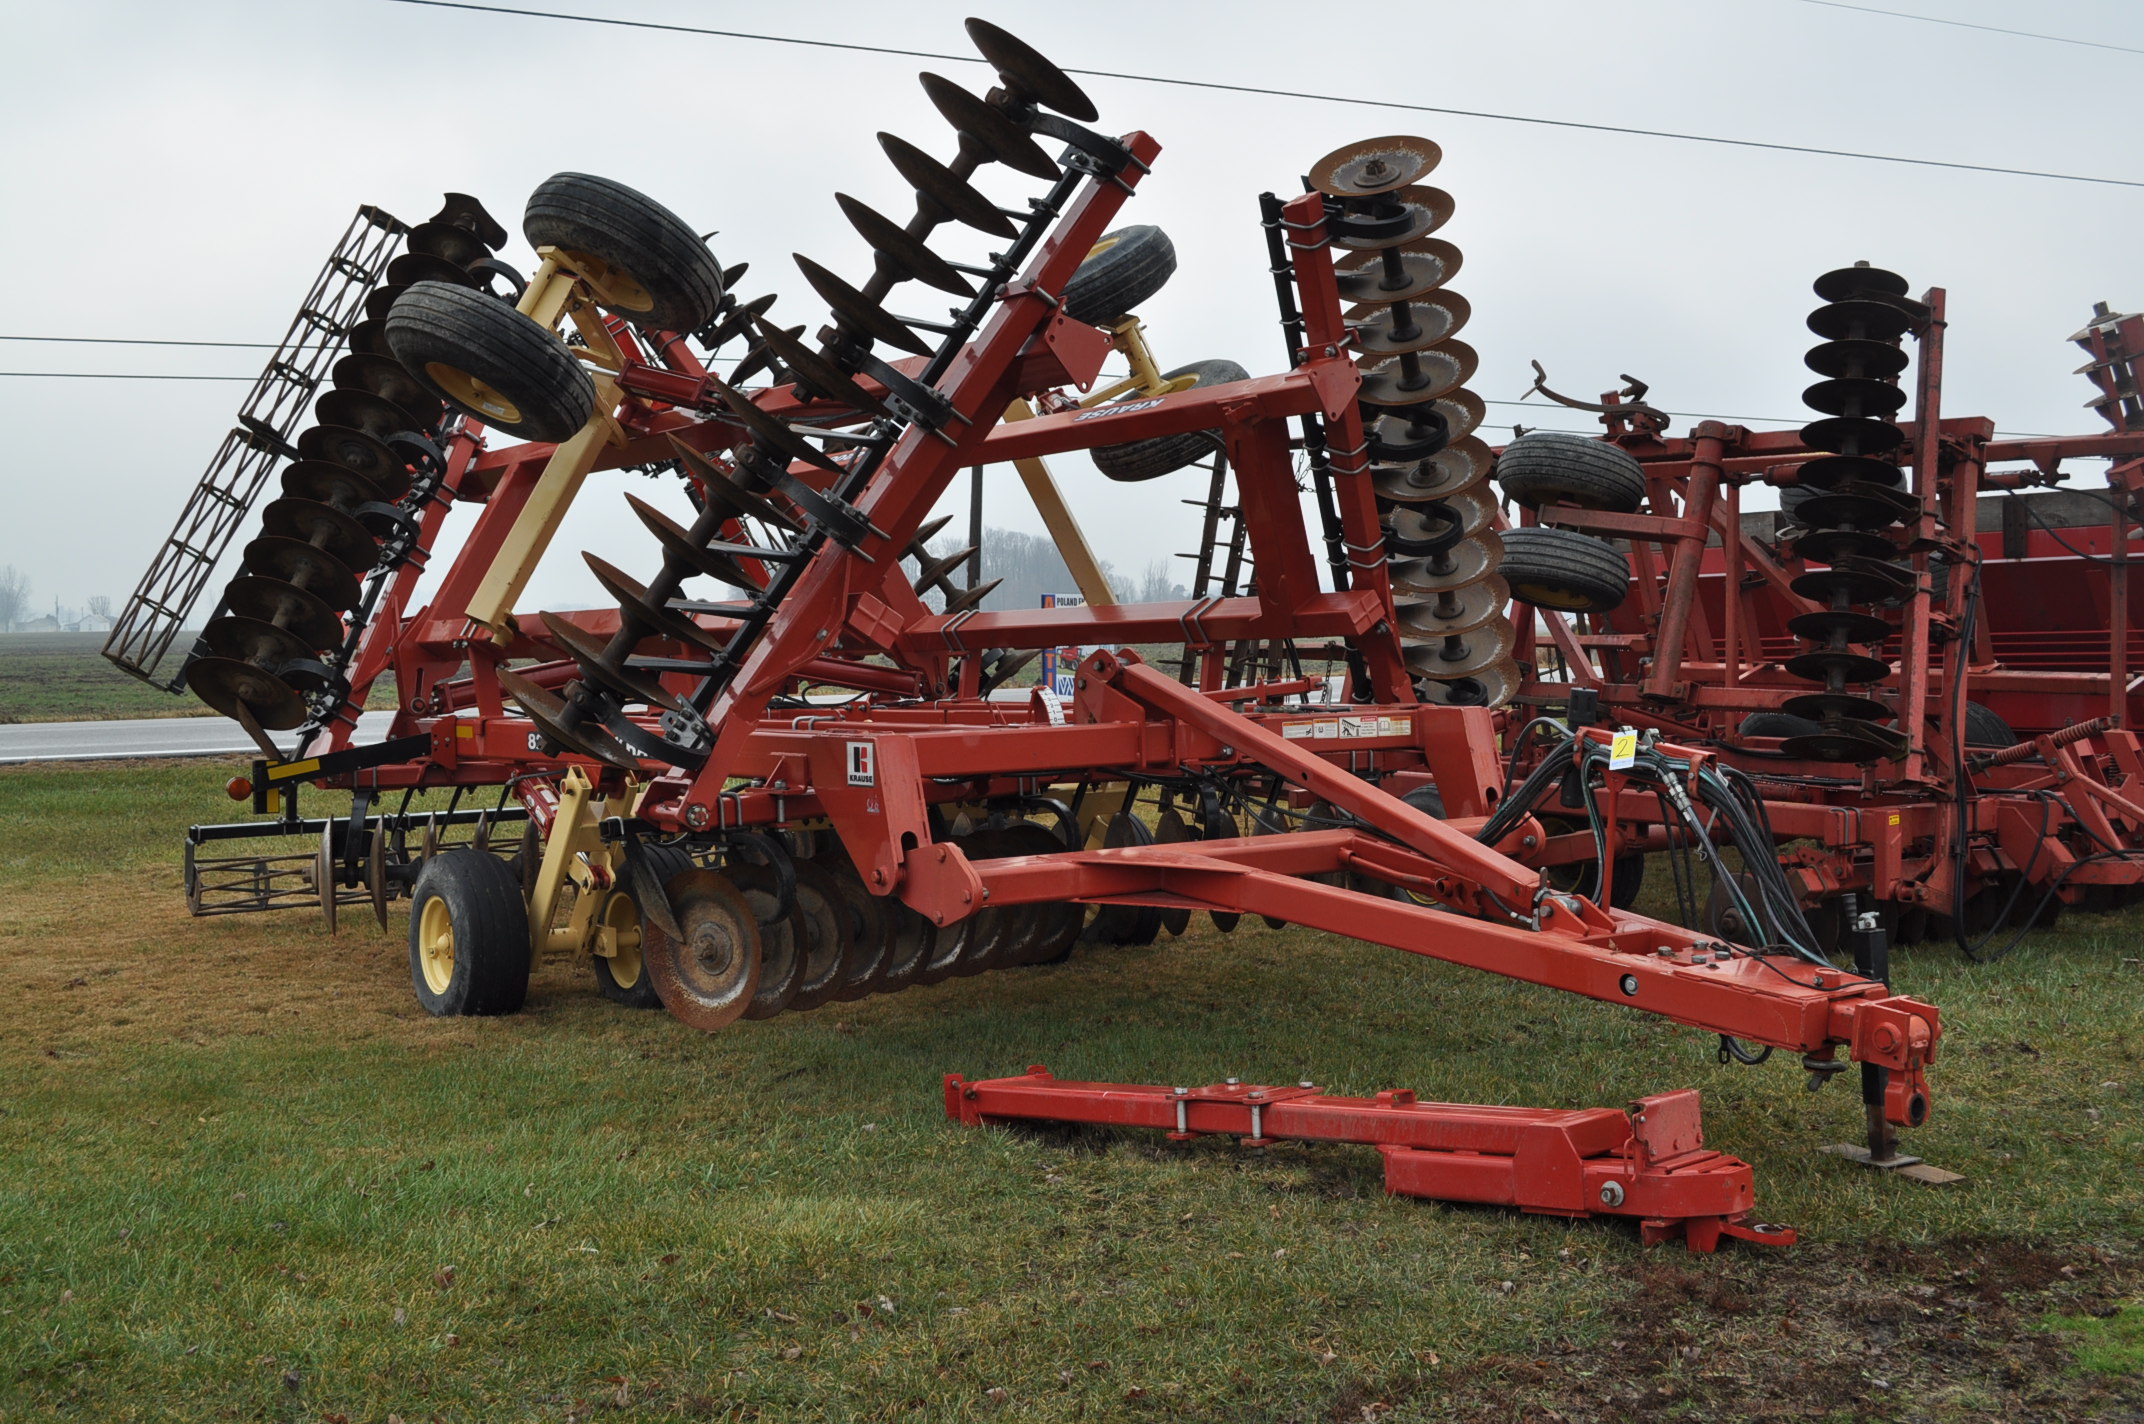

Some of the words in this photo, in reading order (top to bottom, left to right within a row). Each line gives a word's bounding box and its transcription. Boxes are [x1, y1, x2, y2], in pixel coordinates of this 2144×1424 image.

[1073, 398, 1166, 421] KRAUSE
[1616, 738, 1630, 758] 2
[849, 774, 873, 783] KRAUSE
